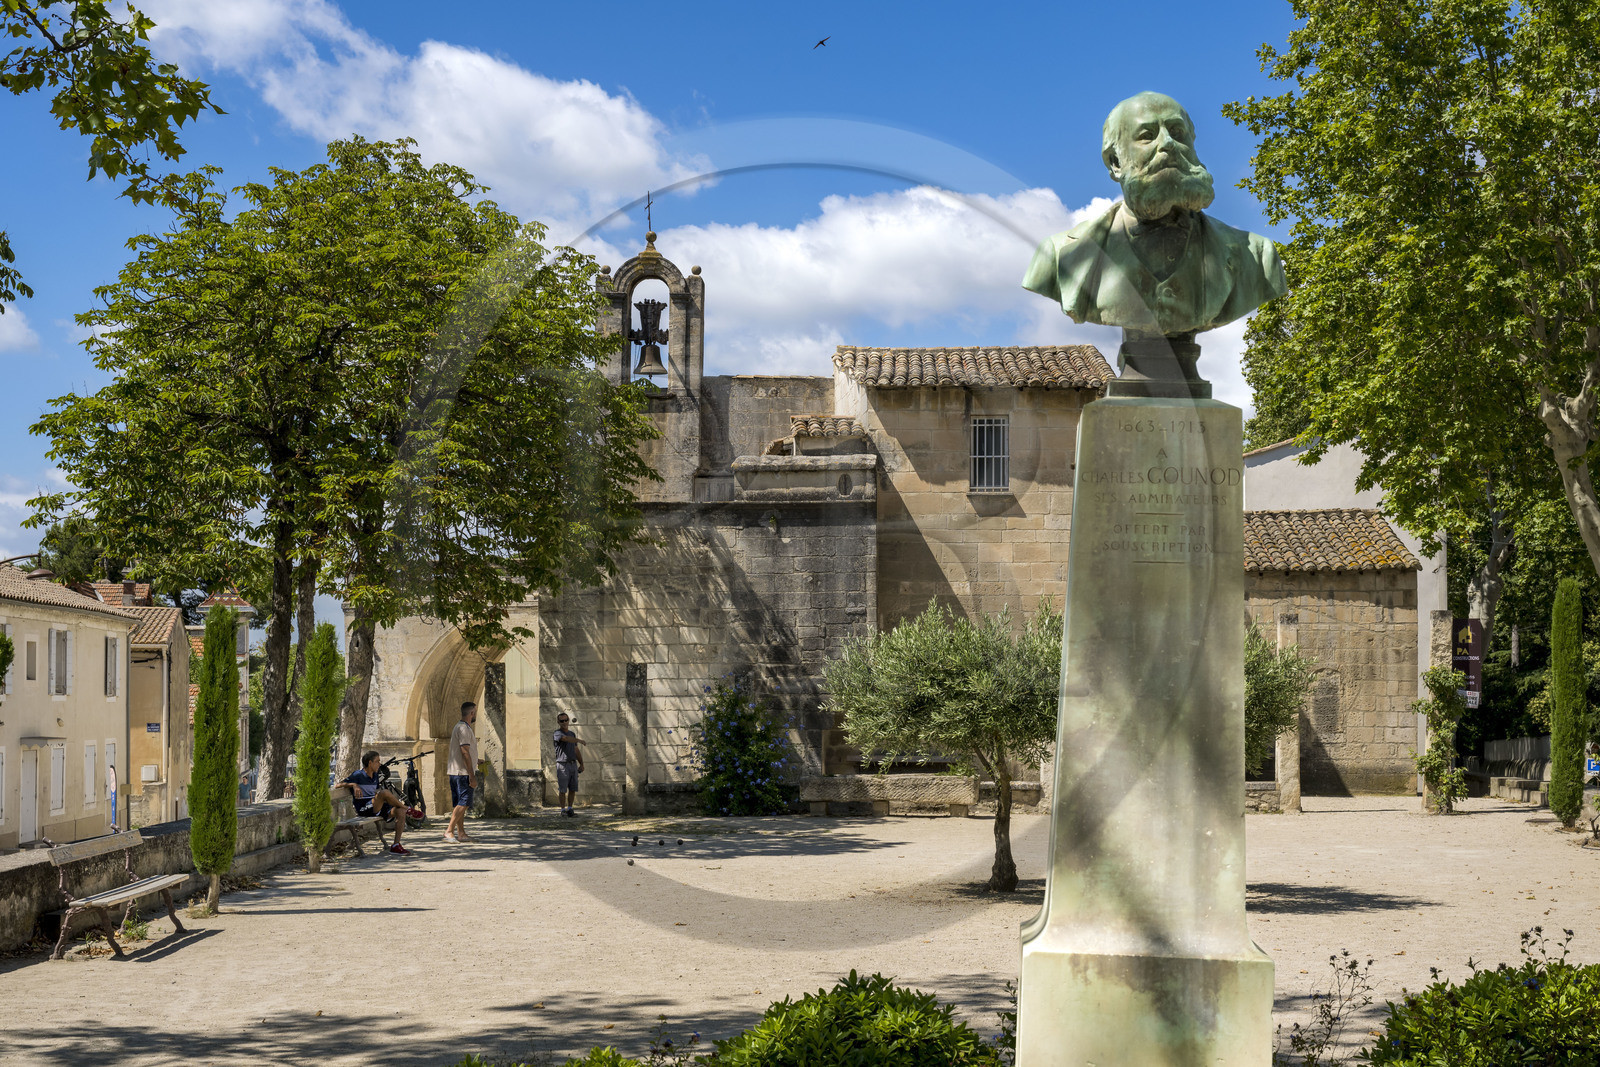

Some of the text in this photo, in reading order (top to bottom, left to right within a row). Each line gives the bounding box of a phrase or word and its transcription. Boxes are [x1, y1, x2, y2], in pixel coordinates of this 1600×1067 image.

[1081, 466, 1241, 486] CHARLES GOUNOD
[1128, 493, 1228, 505] ADMIRATEURS
[1113, 524, 1206, 536] OFFERT PAR
[1102, 540, 1214, 553] SOUSCRIPTION
